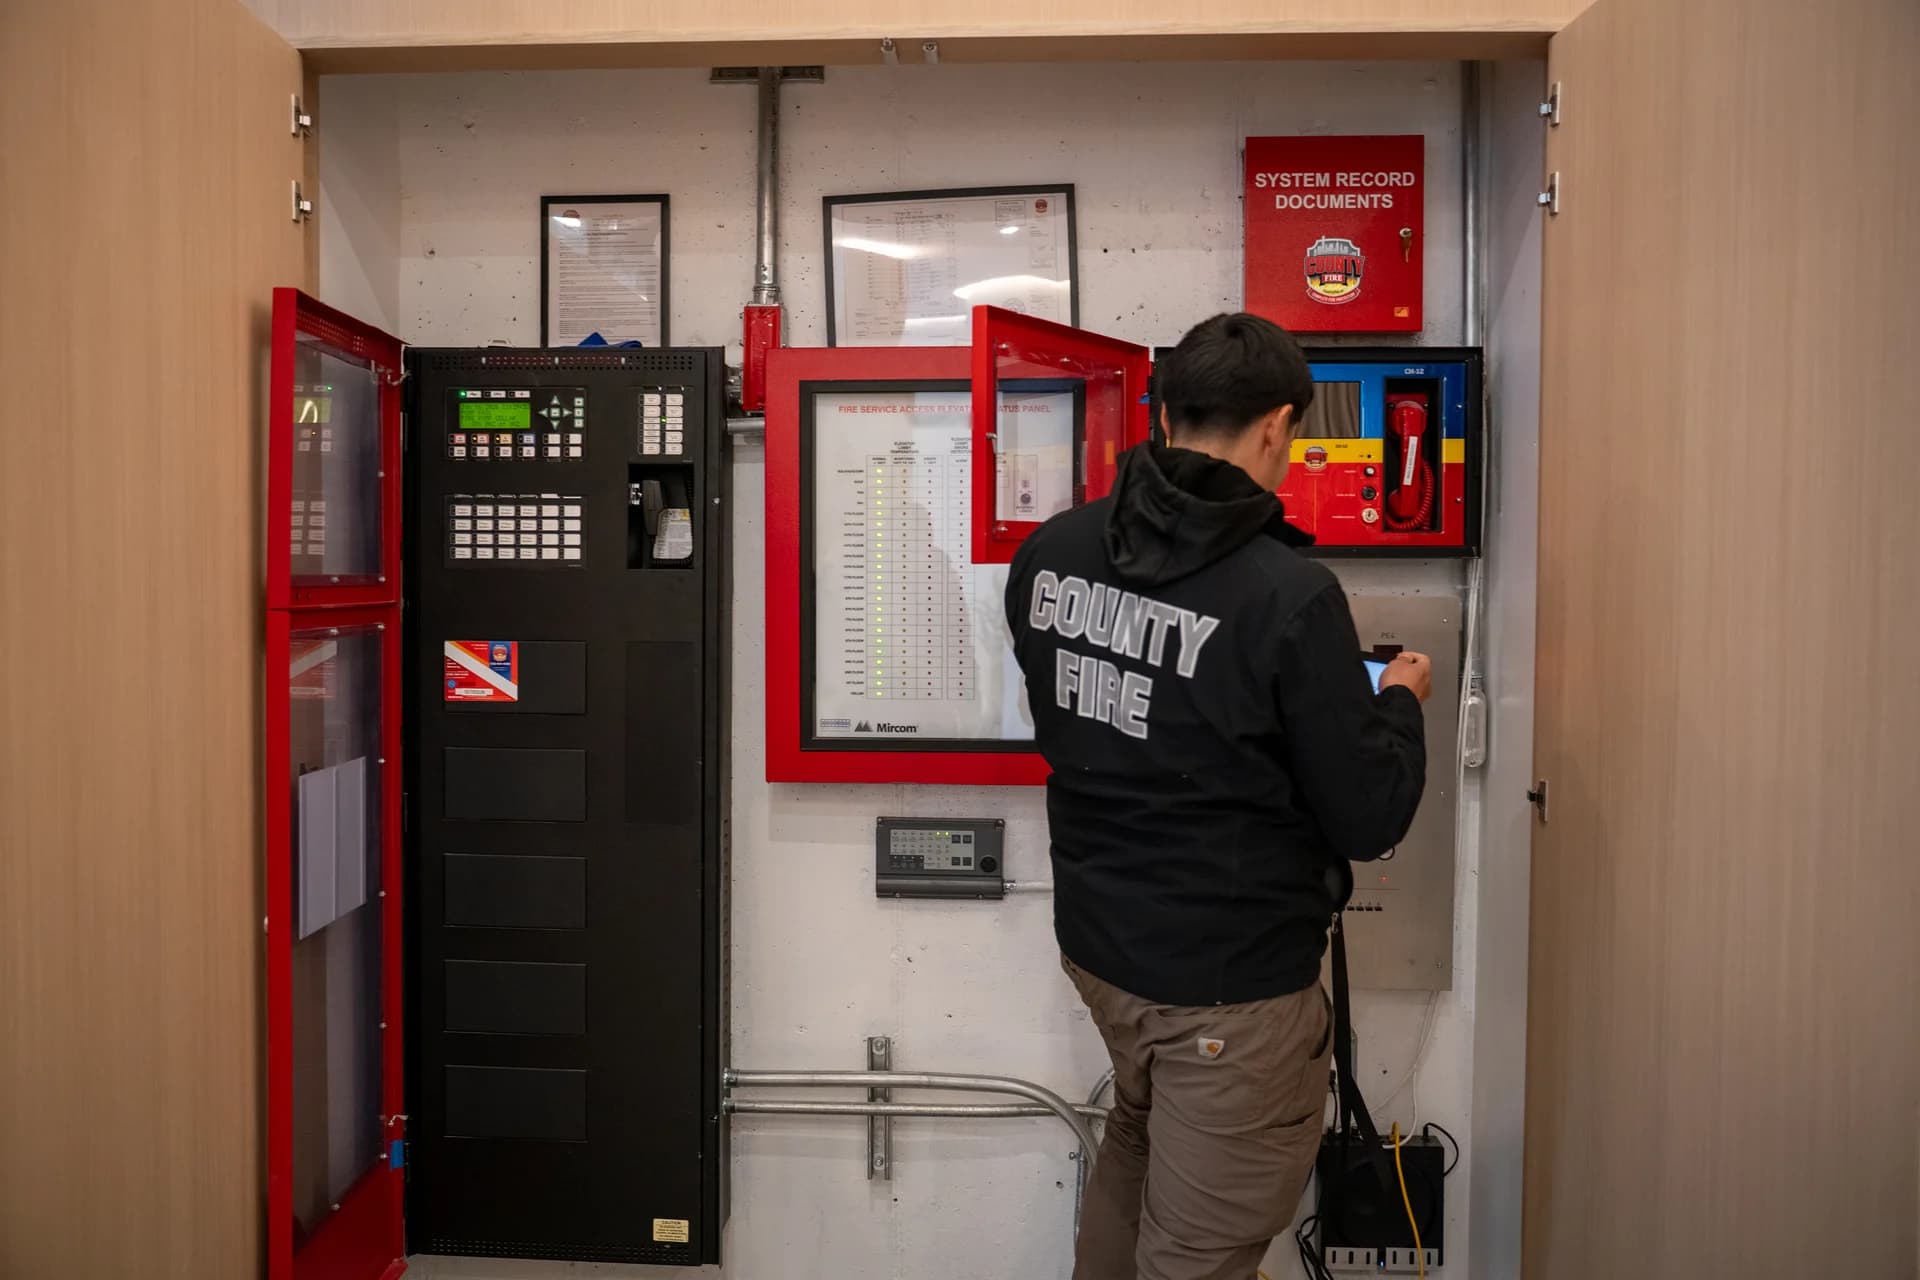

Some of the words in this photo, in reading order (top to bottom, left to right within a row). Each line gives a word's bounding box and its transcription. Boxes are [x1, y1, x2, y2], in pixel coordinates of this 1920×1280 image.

[1255, 172, 1330, 187] SYSTEM
[1336, 171, 1415, 187] RECORD
[1275, 193, 1393, 209] DOCUMENTS
[1305, 255, 1364, 275] COUNTY
[1324, 274, 1343, 282] FIRE
[838, 406, 859, 414] FIRE
[860, 406, 897, 414] SERVICE
[899, 406, 936, 414] ACCESS
[938, 406, 972, 414] ELEVAT
[1022, 404, 1052, 414] PANEL
[1029, 569, 1221, 679] COUNTY
[1055, 648, 1154, 740] FIRE
[876, 722, 917, 733] Mircom
